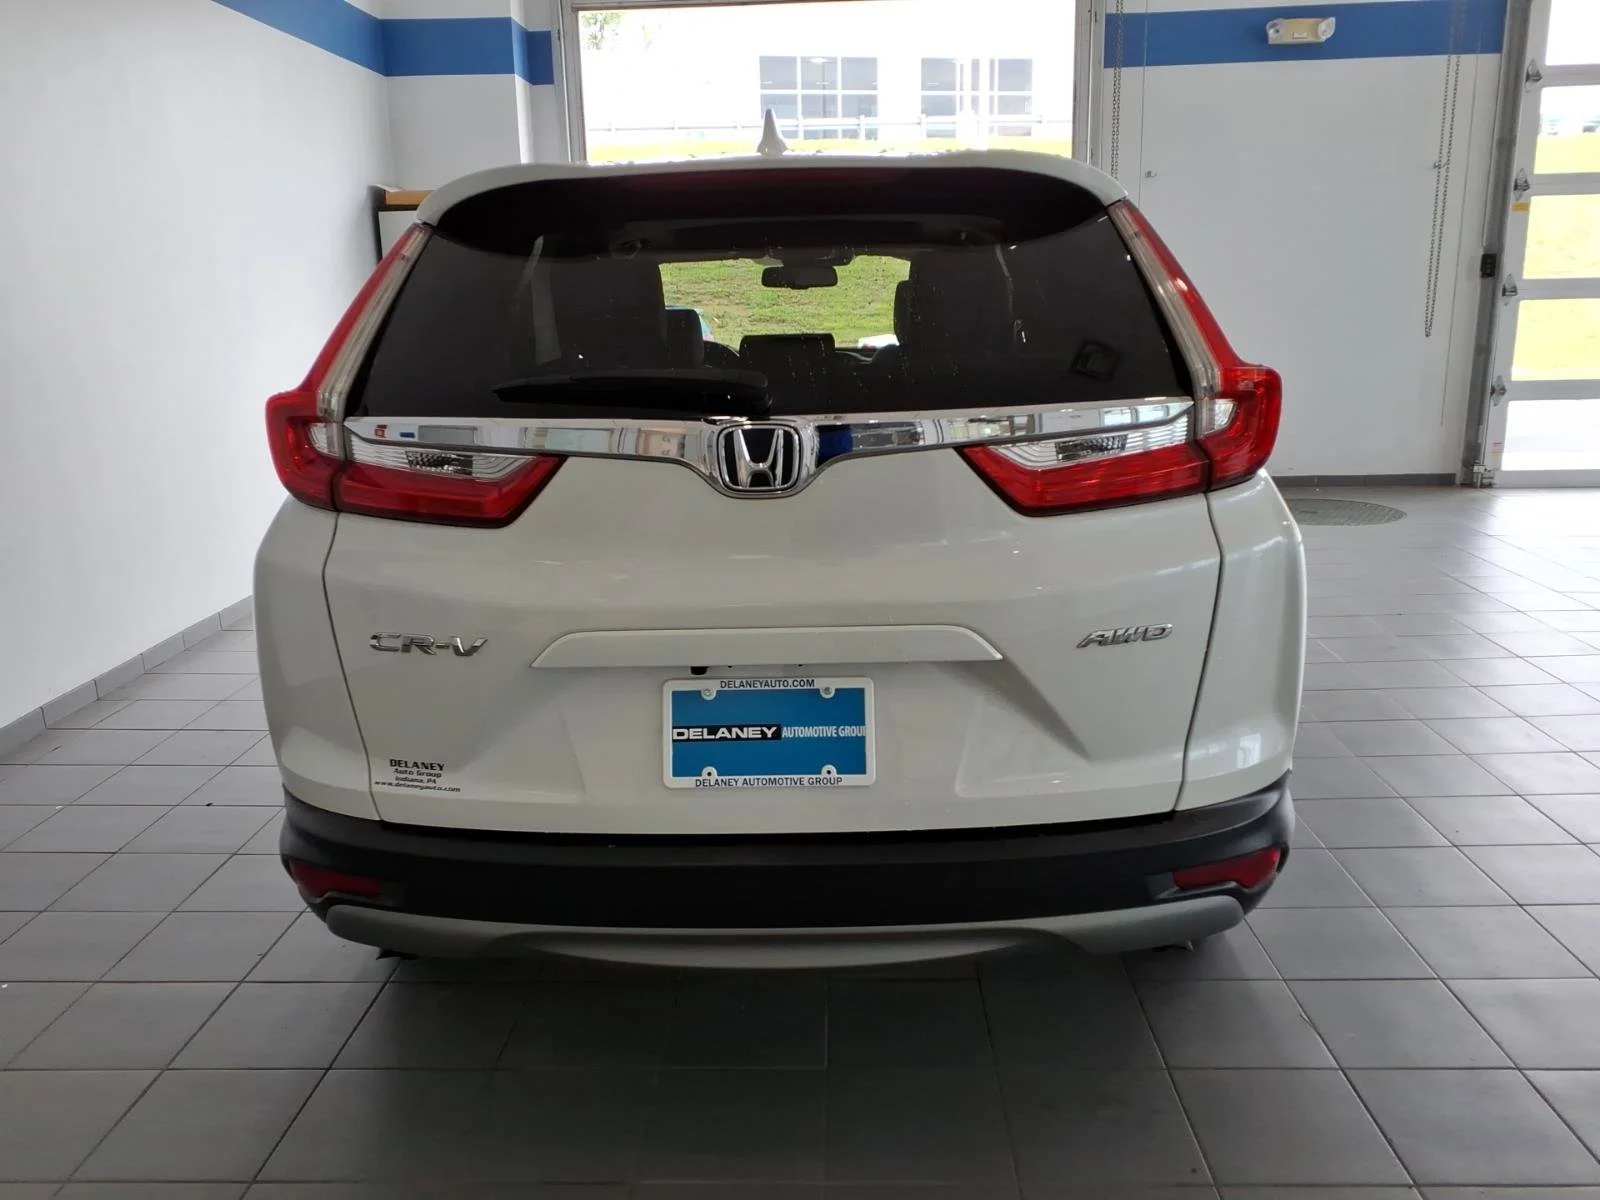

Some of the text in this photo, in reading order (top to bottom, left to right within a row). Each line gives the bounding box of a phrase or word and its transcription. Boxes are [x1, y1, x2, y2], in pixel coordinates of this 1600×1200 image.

[1075, 623, 1173, 649] AWD
[369, 632, 488, 657] CR-V
[719, 679, 816, 689] DELANEYAUTO.COM
[672, 726, 777, 740] DELANEY
[782, 726, 837, 738] AUTOMOTIVE
[389, 758, 445, 771] DELANEY
[695, 776, 843, 787] DELANEY AUTOMOTIVE GROUP
